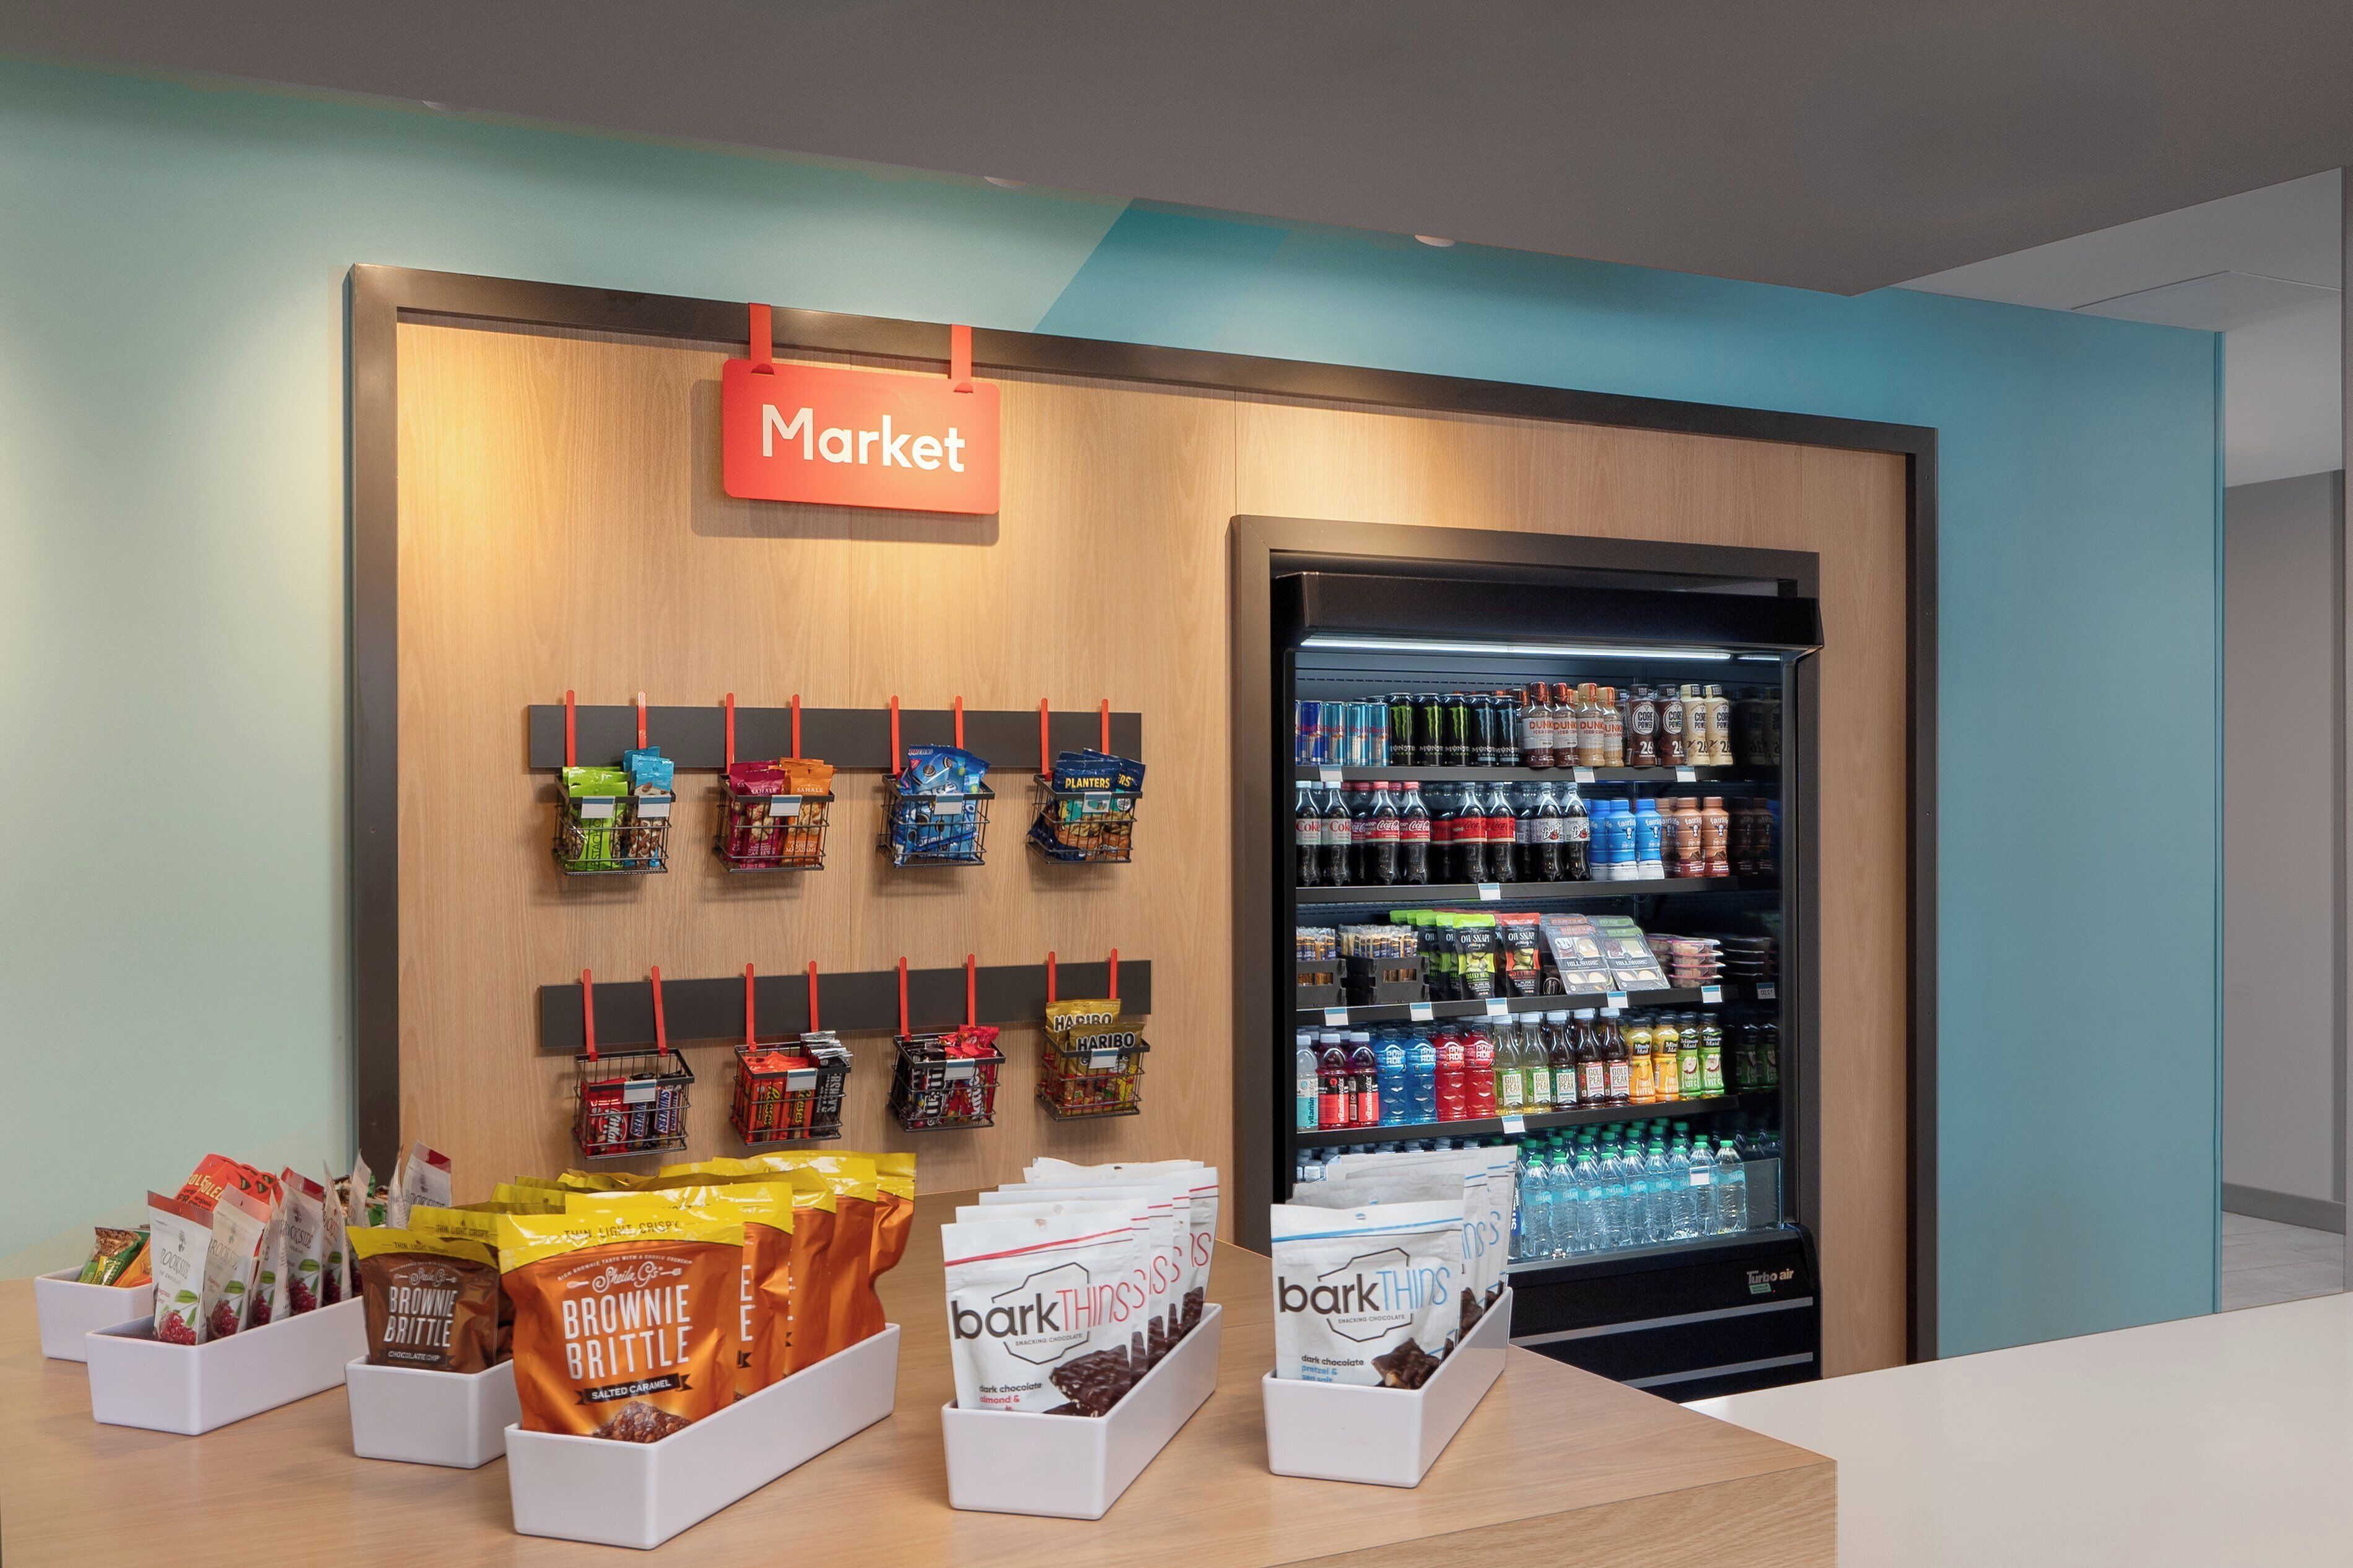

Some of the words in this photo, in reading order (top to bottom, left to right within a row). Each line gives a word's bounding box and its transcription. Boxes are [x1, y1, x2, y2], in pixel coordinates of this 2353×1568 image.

[762, 404, 965, 473] Market
[1638, 712, 1652, 721] CORE
[1065, 777, 1111, 788] PLANTERS
[1296, 821, 1320, 832] Coke
[1617, 817, 1636, 827] fairlif
[591, 819, 601, 866] PSTACHO
[1508, 933, 1517, 941] OH
[1076, 1031, 1135, 1052] HARIBO
[1612, 1067, 1627, 1075] GOLD
[1504, 1076, 1520, 1084] GOLD
[1558, 1074, 1573, 1082] GOLD
[656, 1089, 670, 1132] SNICKERS
[632, 1102, 646, 1136] NICKERS
[573, 1261, 600, 1273] BROWNIE
[601, 1257, 620, 1265] TASTE
[592, 1266, 636, 1293] Sheila
[1747, 1270, 1778, 1284] Turbo
[1779, 1268, 1794, 1280] air
[389, 1286, 458, 1317] BROWNIE
[562, 1284, 691, 1339] BROWNIE
[1369, 1314, 1405, 1322] CHOCOLATE
[383, 1315, 453, 1347] BRITTLE
[1015, 1338, 1047, 1346] SNACKING
[1049, 1334, 1082, 1343] CHOCOLATE
[388, 1351, 426, 1361] CHOCOLATE
[565, 1326, 692, 1380] BRITTLE
[1301, 1354, 1320, 1364] dark
[1321, 1356, 1364, 1366] chocolate
[1301, 1364, 1329, 1375] pretzel
[1331, 1367, 1338, 1375] &
[592, 1387, 627, 1400] SALTED
[629, 1379, 673, 1396] CARAMEL
[979, 1383, 997, 1393] dark
[999, 1382, 1042, 1392] chocolate
[980, 1395, 1011, 1405] almond
[1013, 1395, 1020, 1403] &
